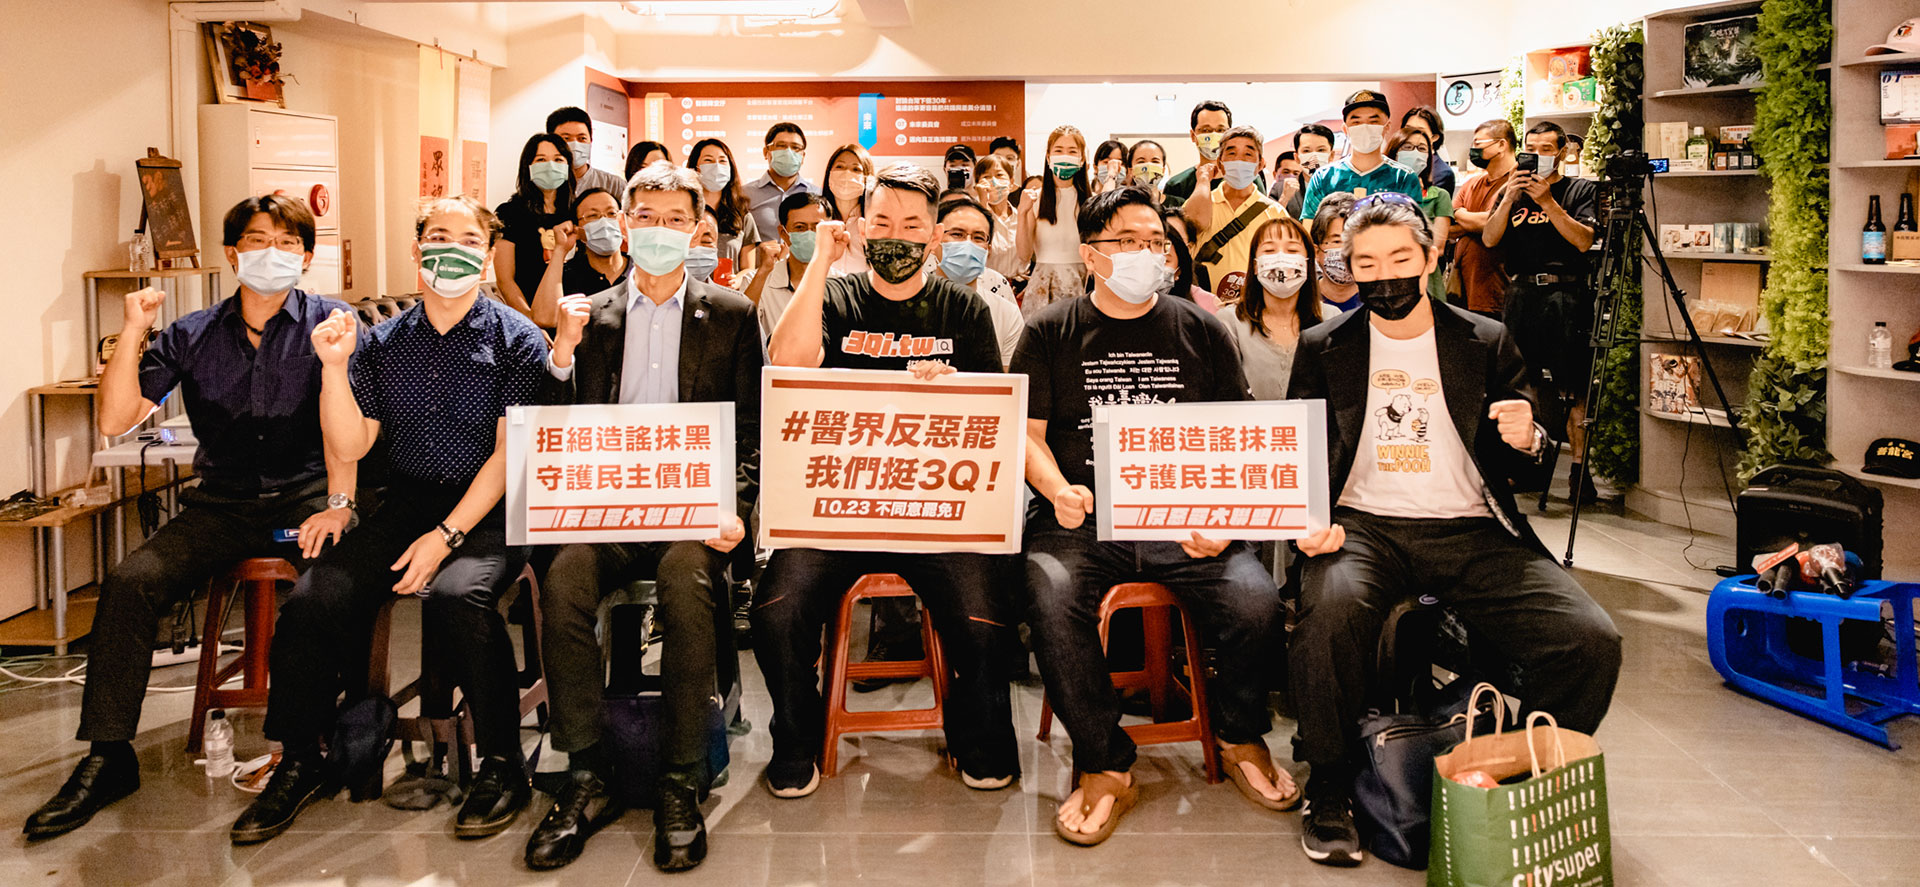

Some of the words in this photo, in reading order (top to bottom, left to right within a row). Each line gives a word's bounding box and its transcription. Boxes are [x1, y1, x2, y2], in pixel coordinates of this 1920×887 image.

[1527, 210, 1549, 224] asi
[537, 425, 711, 453] 拒絕造謠抹黑
[781, 410, 1001, 449] #醫界反惡罷
[1119, 426, 1298, 452] 拒絕造謠抹黑
[1376, 444, 1429, 460] WINNIE
[537, 462, 711, 491] 守護民主價值
[805, 455, 1001, 492] 我們挺3Q！
[1120, 463, 1299, 490] 守護民主價值
[1395, 458, 1431, 473] POOH
[819, 499, 870, 515] 10.23
[875, 500, 963, 518] 不同意罷免！
